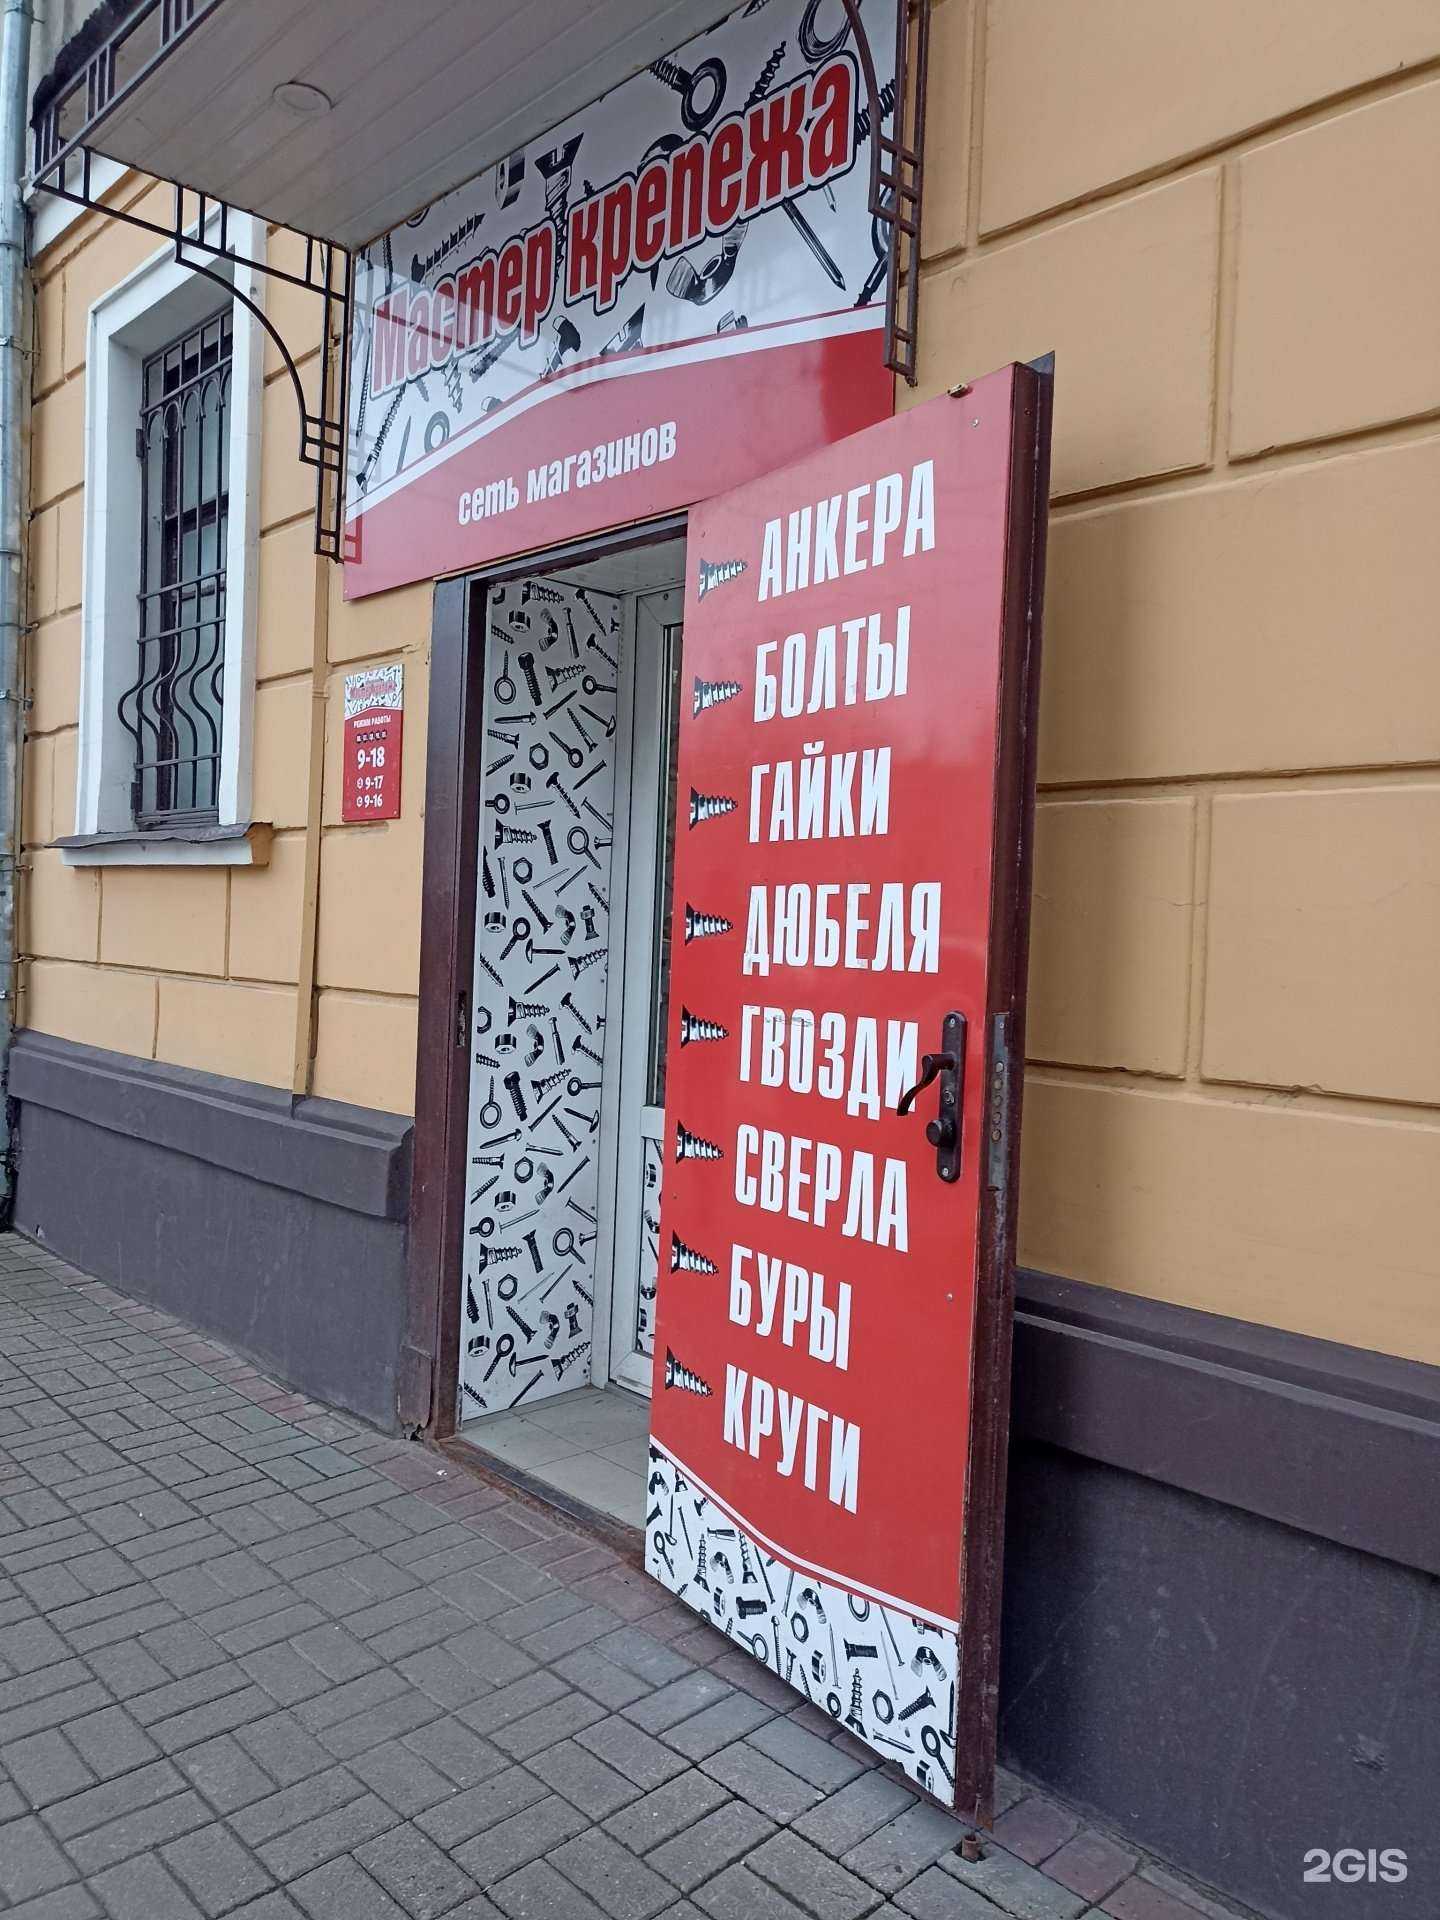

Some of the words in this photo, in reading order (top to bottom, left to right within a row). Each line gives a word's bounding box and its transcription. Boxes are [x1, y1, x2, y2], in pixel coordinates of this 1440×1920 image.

[370, 223, 556, 396] Мастер
[568, 56, 855, 308] крепежа
[457, 481, 520, 526] сеть
[526, 420, 678, 506] магазинов
[757, 458, 936, 603] АНКЕРА
[752, 604, 912, 724] БОЛТЫ
[357, 745, 385, 770] 9-18
[364, 775, 384, 790] 9-17
[364, 793, 383, 808] 9-16
[748, 739, 893, 844] ГАЙКИ
[742, 881, 943, 977] ДЮБЕЛЯ
[738, 1003, 920, 1122] ГВОЗДИ
[733, 1122, 910, 1255] СВЕРЛА
[727, 1242, 853, 1373] БУРЫ
[722, 1362, 862, 1516] КРУГИ
